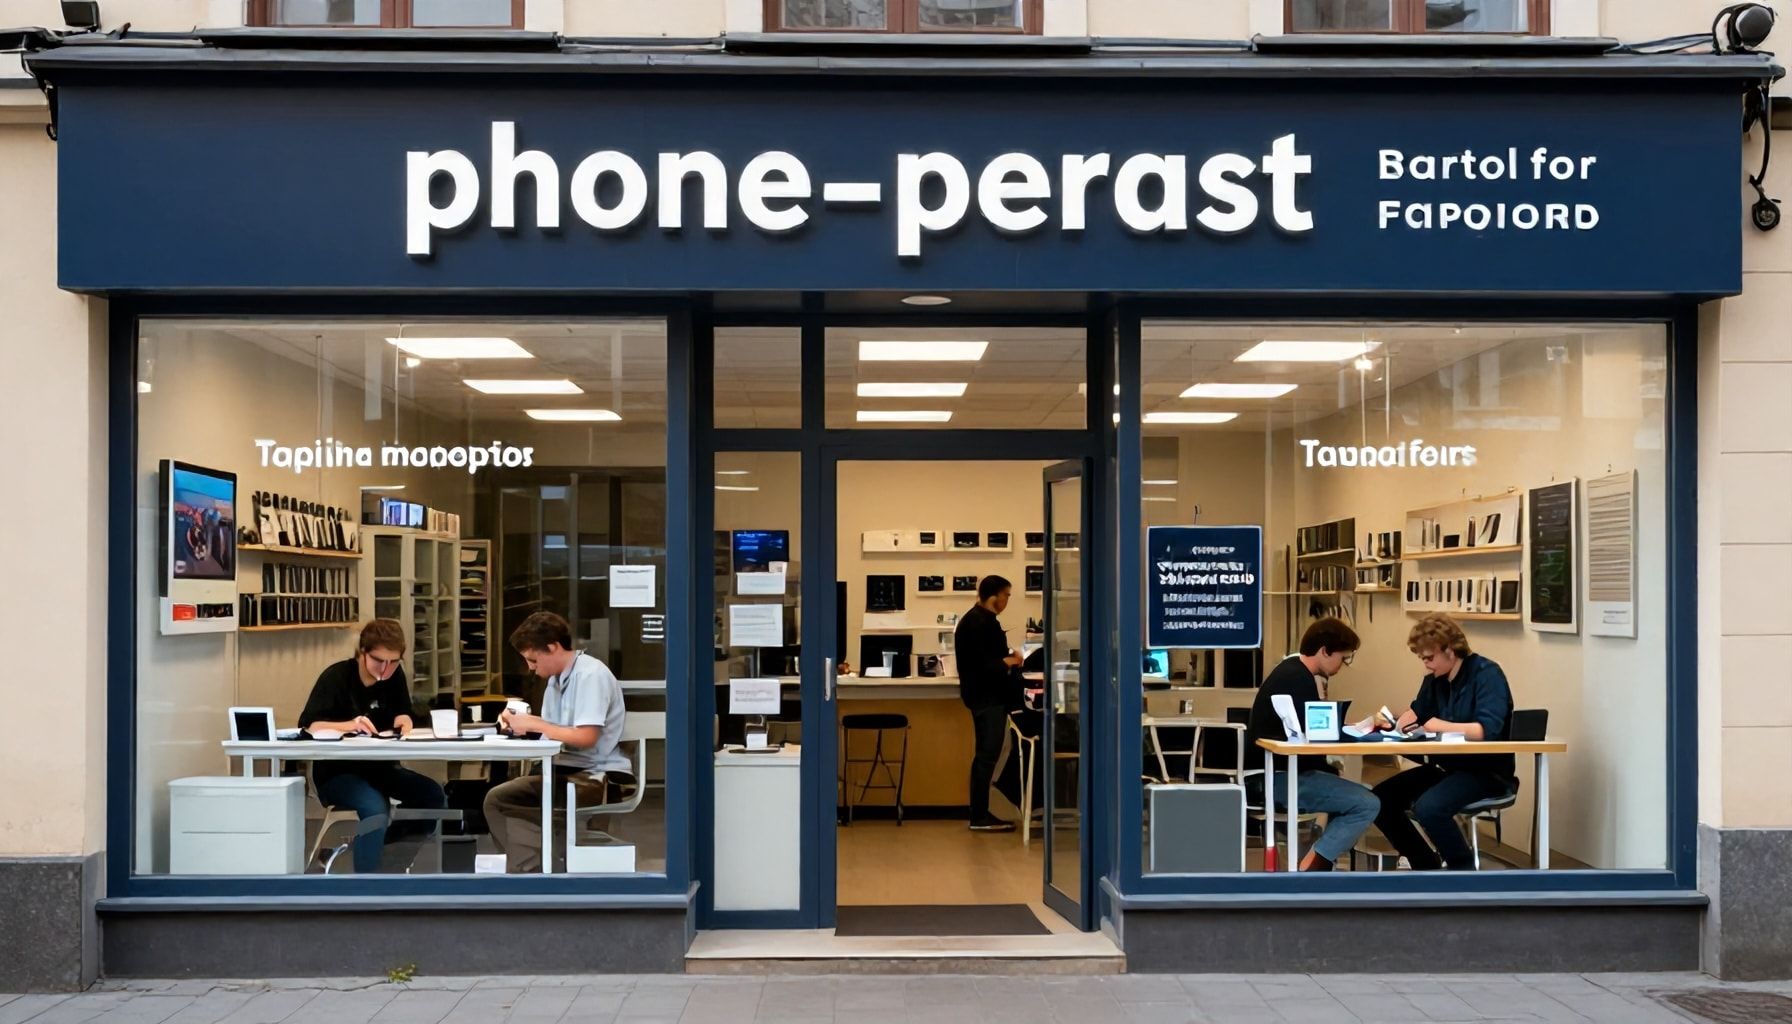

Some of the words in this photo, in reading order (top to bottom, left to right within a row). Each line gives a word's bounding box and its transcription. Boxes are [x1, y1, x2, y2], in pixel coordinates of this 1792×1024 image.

[406, 120, 1315, 257] phone-perast
[1379, 147, 1518, 181] Bartol
[1530, 146, 1597, 181] for
